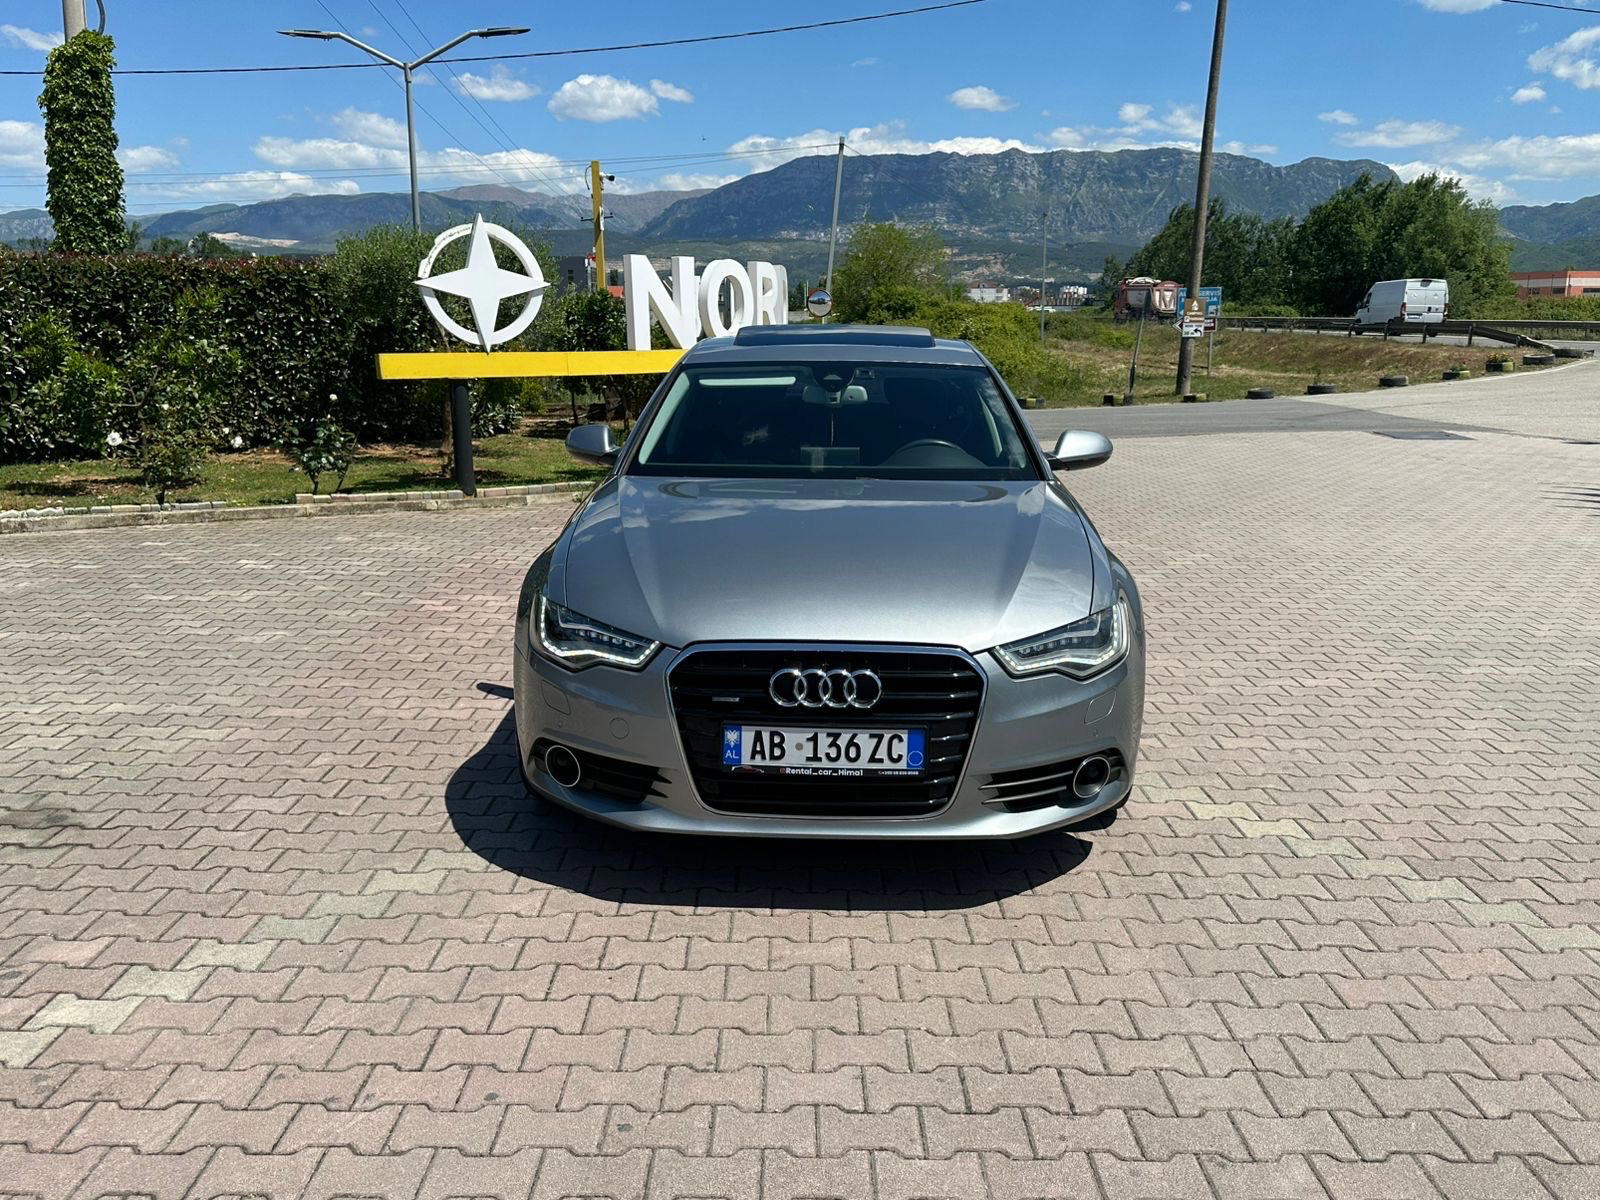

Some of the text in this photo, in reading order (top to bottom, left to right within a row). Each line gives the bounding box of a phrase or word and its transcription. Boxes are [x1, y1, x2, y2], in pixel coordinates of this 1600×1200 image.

[725, 749, 740, 759] AL
[749, 730, 905, 764] AB 136 ZC
